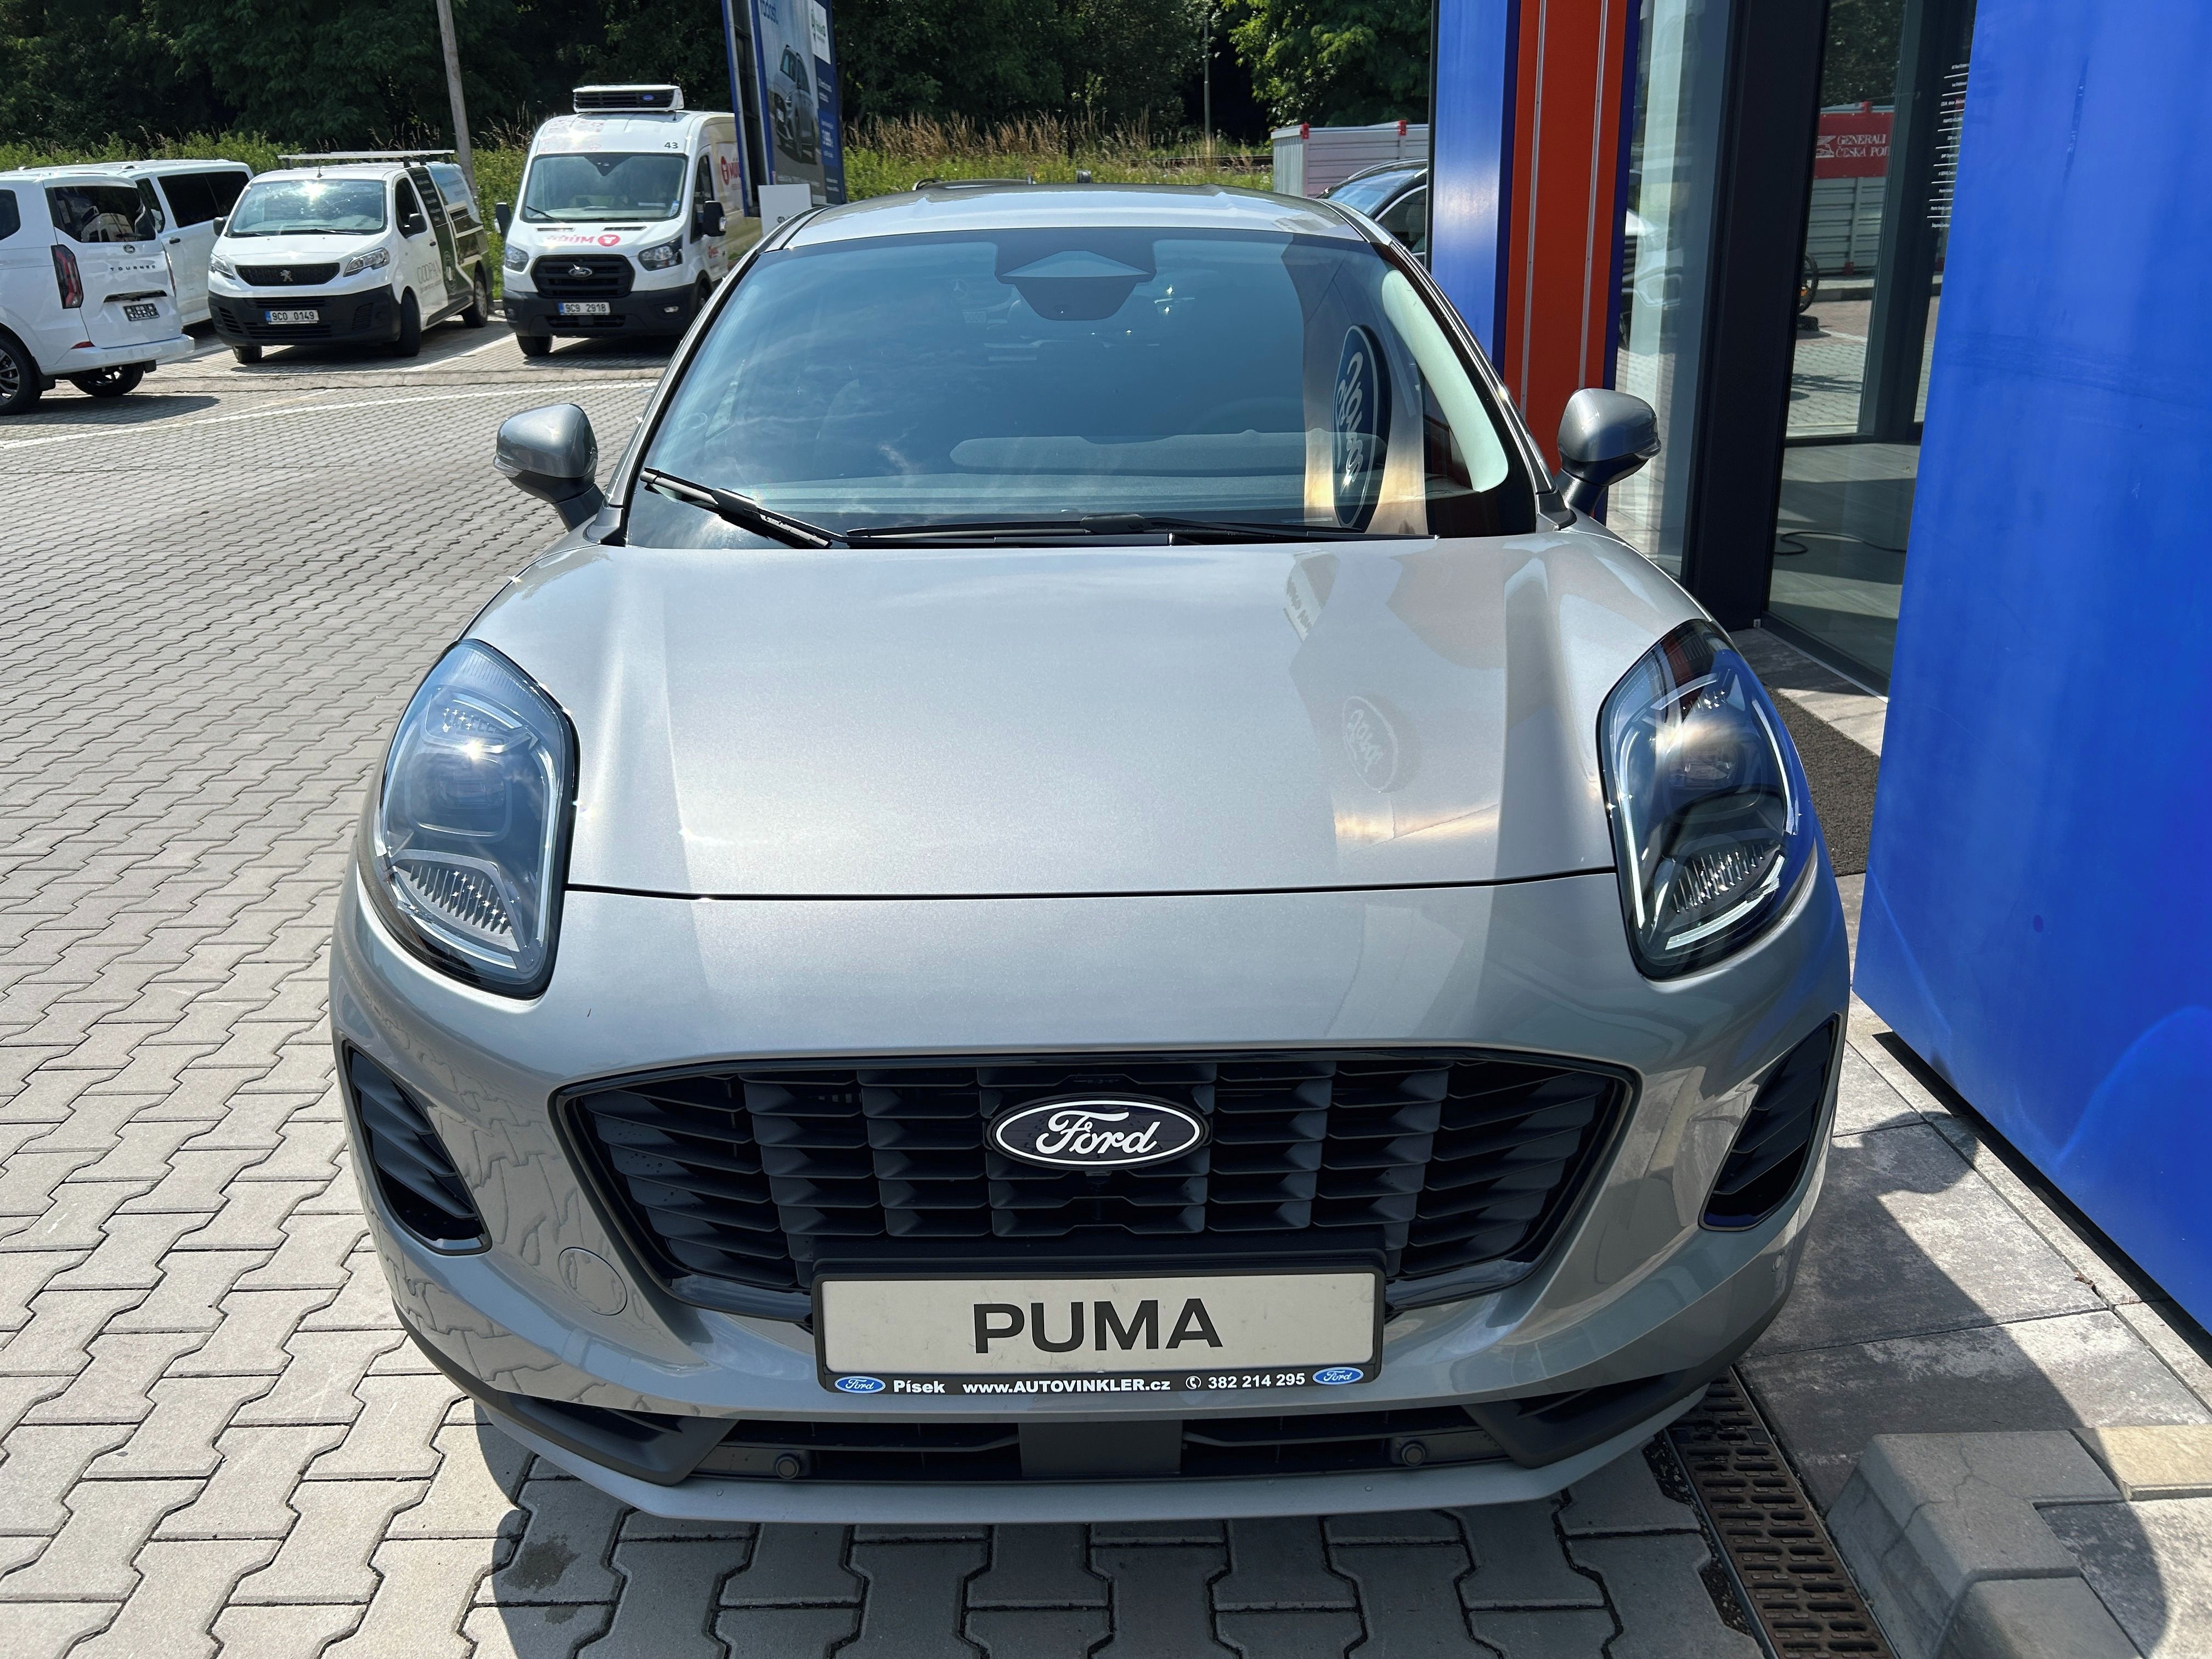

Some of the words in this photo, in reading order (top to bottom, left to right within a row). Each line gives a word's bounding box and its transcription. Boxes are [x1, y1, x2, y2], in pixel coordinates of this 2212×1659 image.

[1837, 134, 1887, 145] GENERALI
[1836, 145, 1866, 157] ČESKÁ
[272, 312, 288, 320] 9C0
[294, 311, 314, 320] 0149
[1036, 1110, 1161, 1154] Ford
[973, 1297, 1223, 1354] PUMA
[845, 1378, 874, 1390] Ford
[893, 1379, 946, 1393] Písek
[962, 1379, 1171, 1393] www.AUTOVINKLER.cz
[1208, 1376, 1237, 1389] 382
[1242, 1374, 1272, 1388] 214
[1276, 1373, 1306, 1386] 295
[1323, 1369, 1352, 1382] Ford
